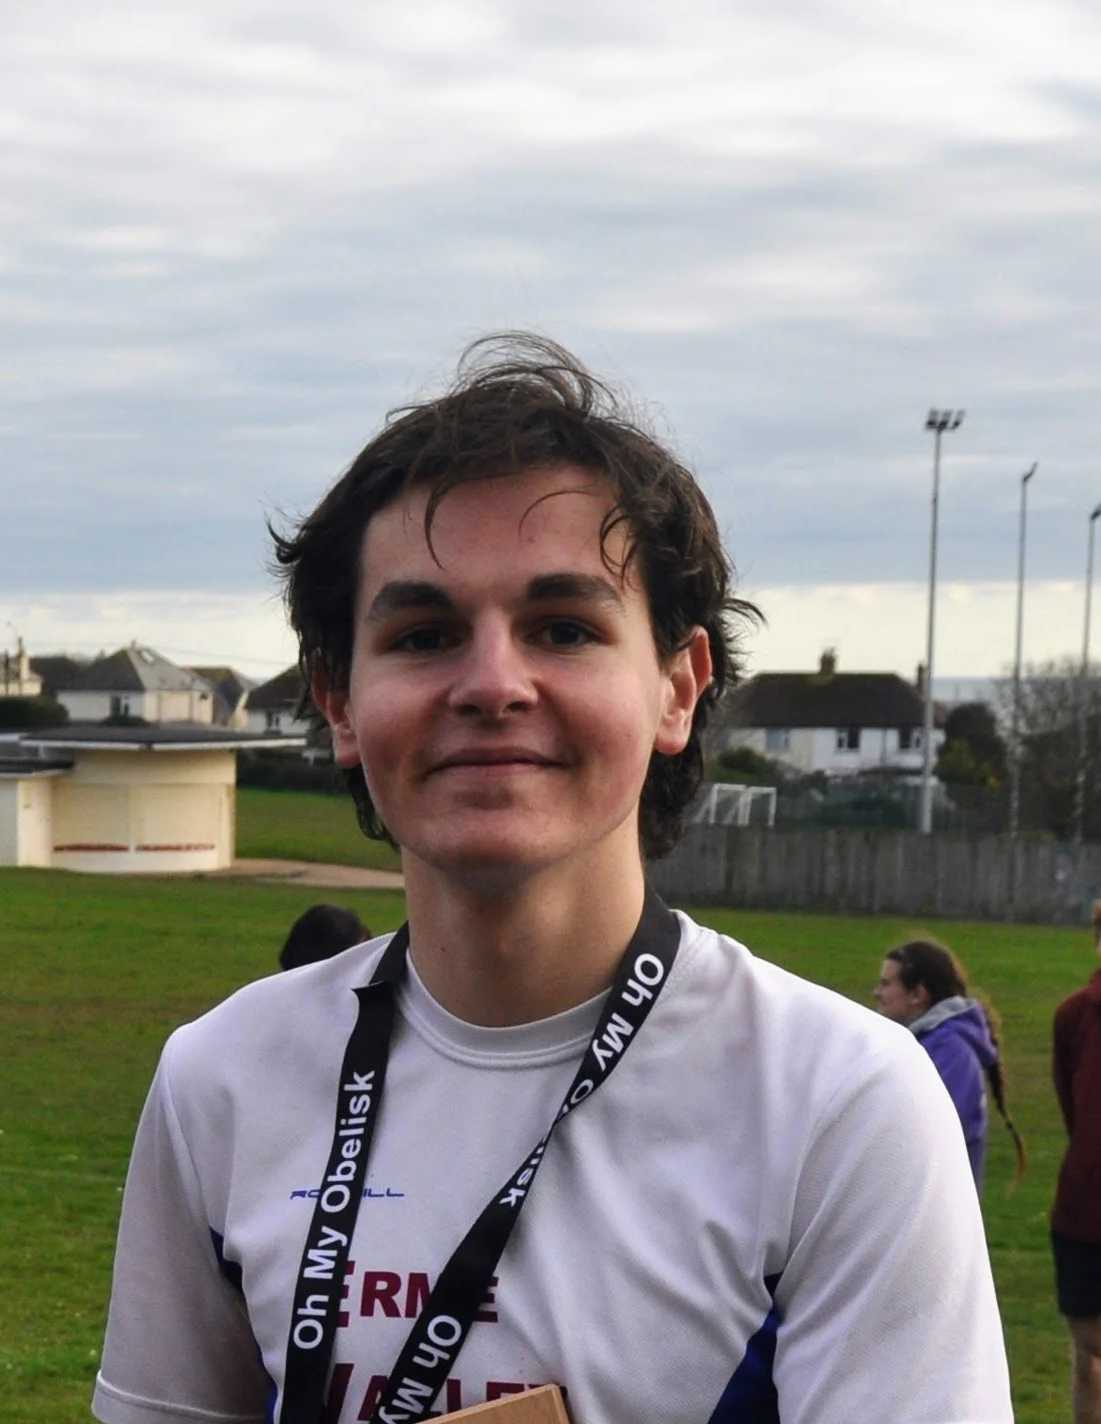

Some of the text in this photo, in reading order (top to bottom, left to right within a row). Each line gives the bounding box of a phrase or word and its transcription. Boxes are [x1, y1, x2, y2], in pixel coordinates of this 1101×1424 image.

[617, 952, 666, 1008] Oh
[591, 1012, 634, 1072] My
[292, 1069, 376, 1350] Oh My Obelisk
[411, 1314, 463, 1369] Oh
